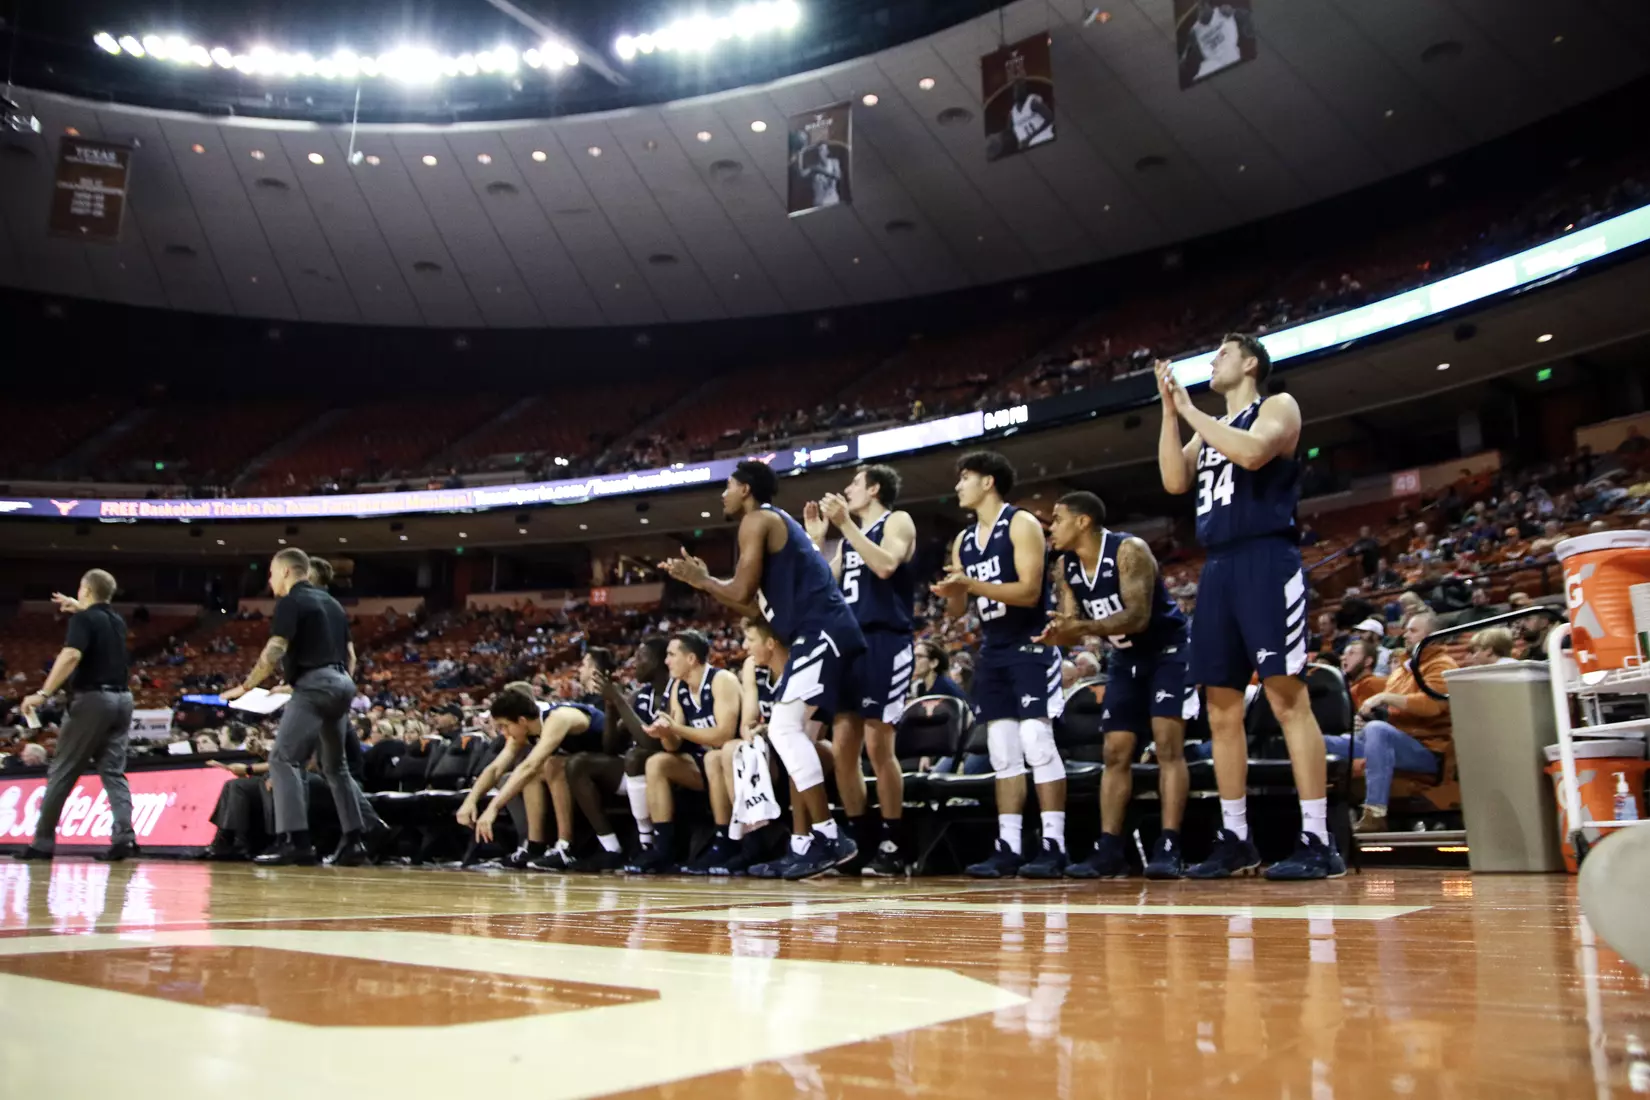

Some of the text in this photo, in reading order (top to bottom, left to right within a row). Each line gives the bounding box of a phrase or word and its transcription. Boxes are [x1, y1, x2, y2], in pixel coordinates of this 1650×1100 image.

[1196, 446, 1228, 471] CB
[1196, 462, 1235, 517] 34
[100, 501, 138, 517] FREE
[139, 500, 211, 517] Basketball
[213, 500, 260, 516] Tickets
[966, 555, 1001, 581] CBU
[843, 569, 861, 604] 5
[1565, 573, 1584, 609] G
[1082, 593, 1123, 621] CBU
